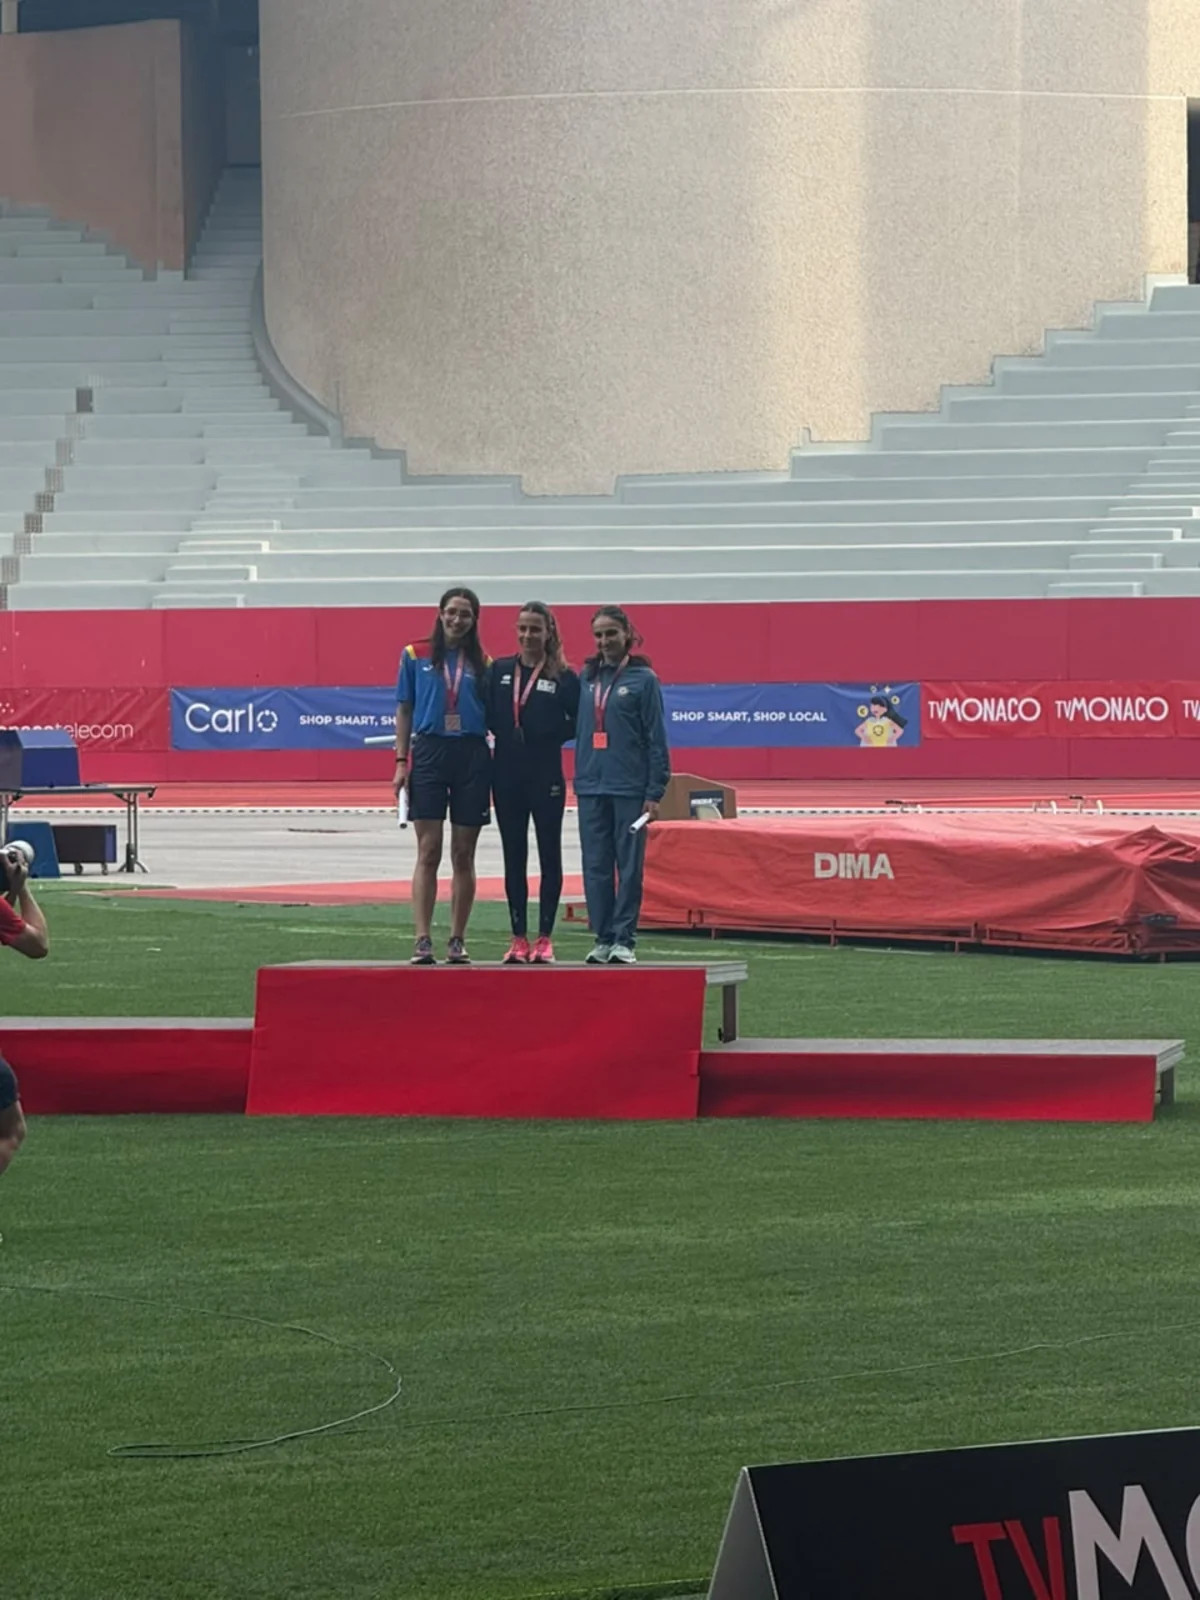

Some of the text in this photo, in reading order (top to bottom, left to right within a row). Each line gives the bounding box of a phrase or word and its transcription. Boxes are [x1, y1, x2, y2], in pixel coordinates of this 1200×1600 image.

[185, 703, 278, 733] Carlo
[300, 715, 397, 727] SHOP SMART, SH
[671, 711, 827, 723] SHOP SMART, SHOP LOCAL
[1182, 700, 1200, 721] TV
[814, 852, 895, 880] DIMA
[952, 1485, 1200, 1600] TVM
